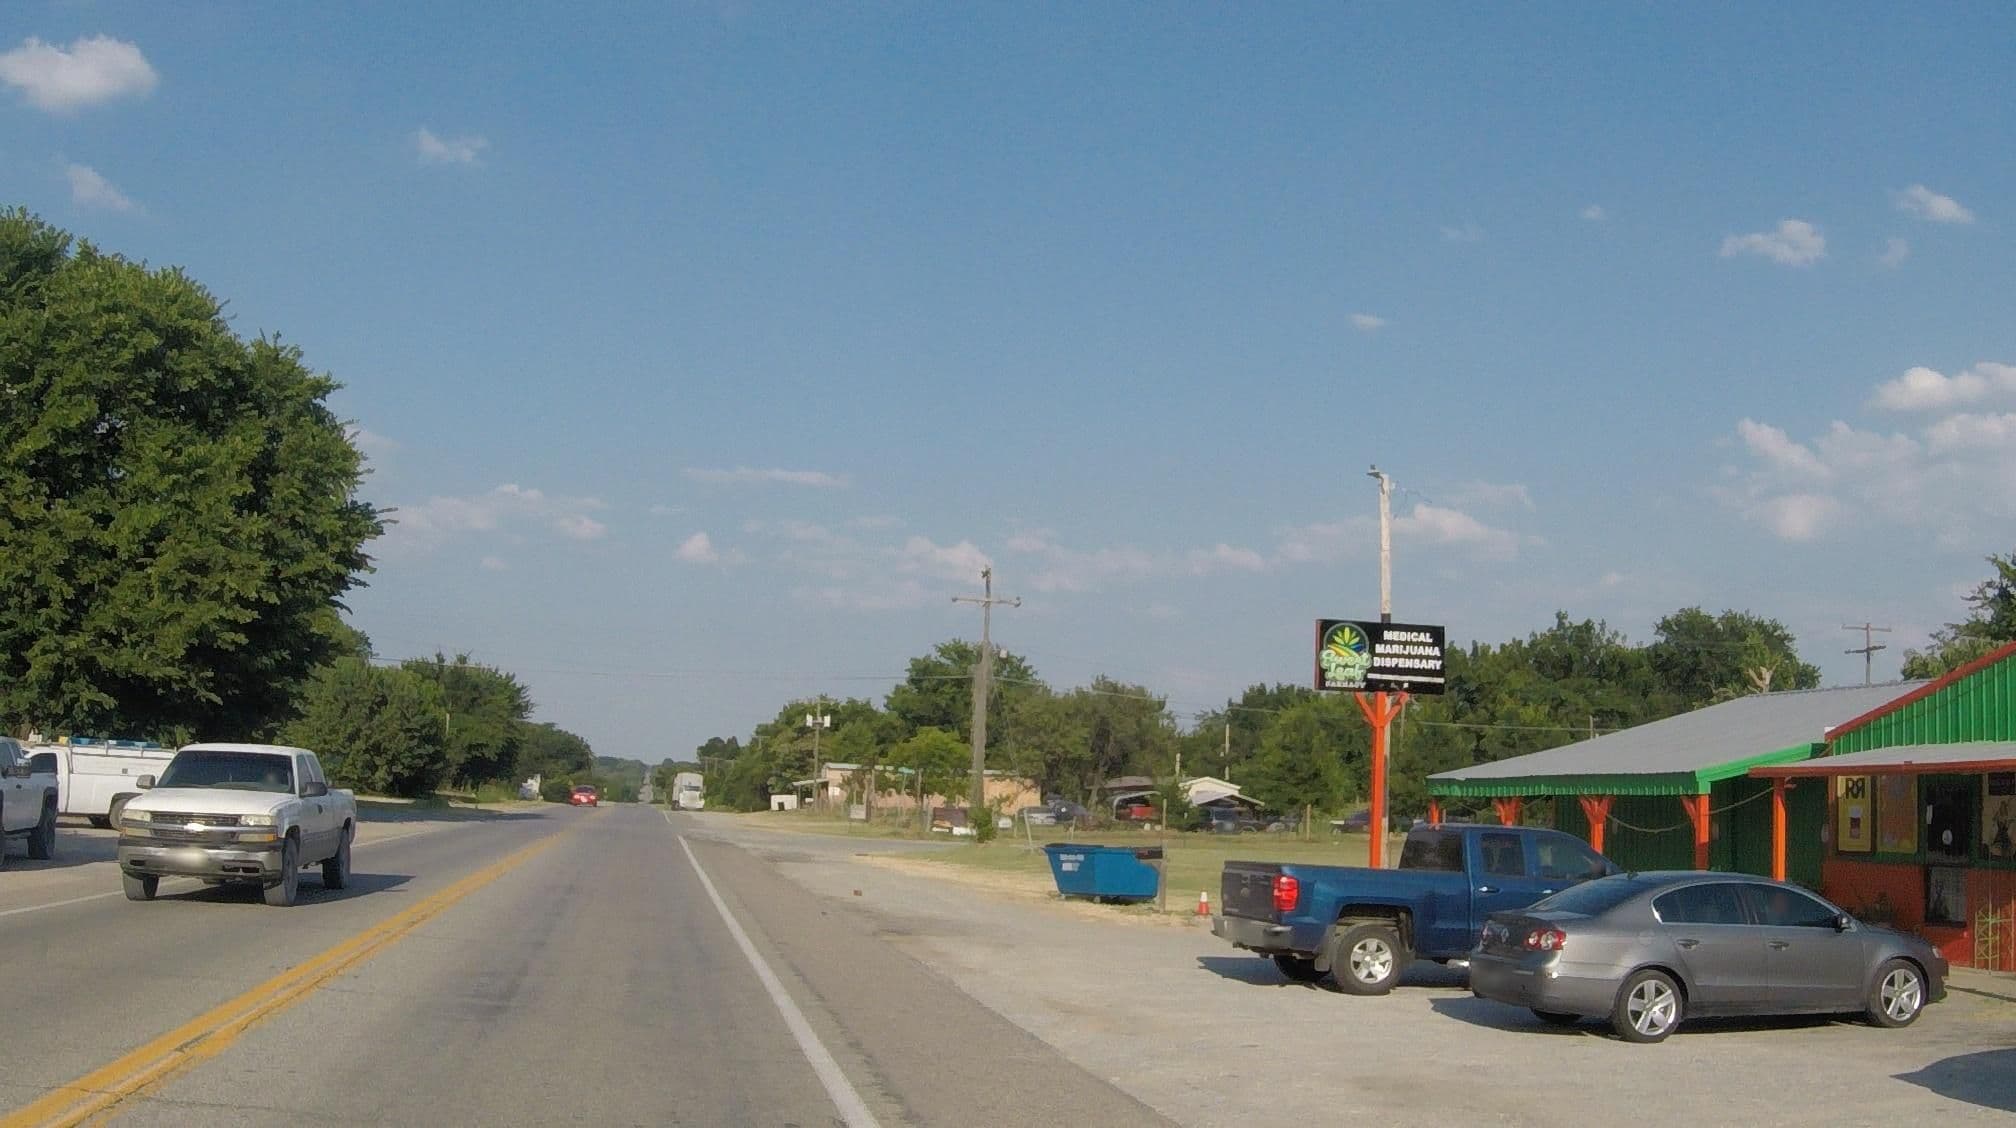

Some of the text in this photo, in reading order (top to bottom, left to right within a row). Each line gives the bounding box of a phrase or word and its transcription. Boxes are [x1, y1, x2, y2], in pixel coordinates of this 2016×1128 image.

[1383, 630, 1433, 643] MEDICAL
[1375, 643, 1441, 657] MARIJUANA
[1373, 656, 1443, 670] DISPENSARY
